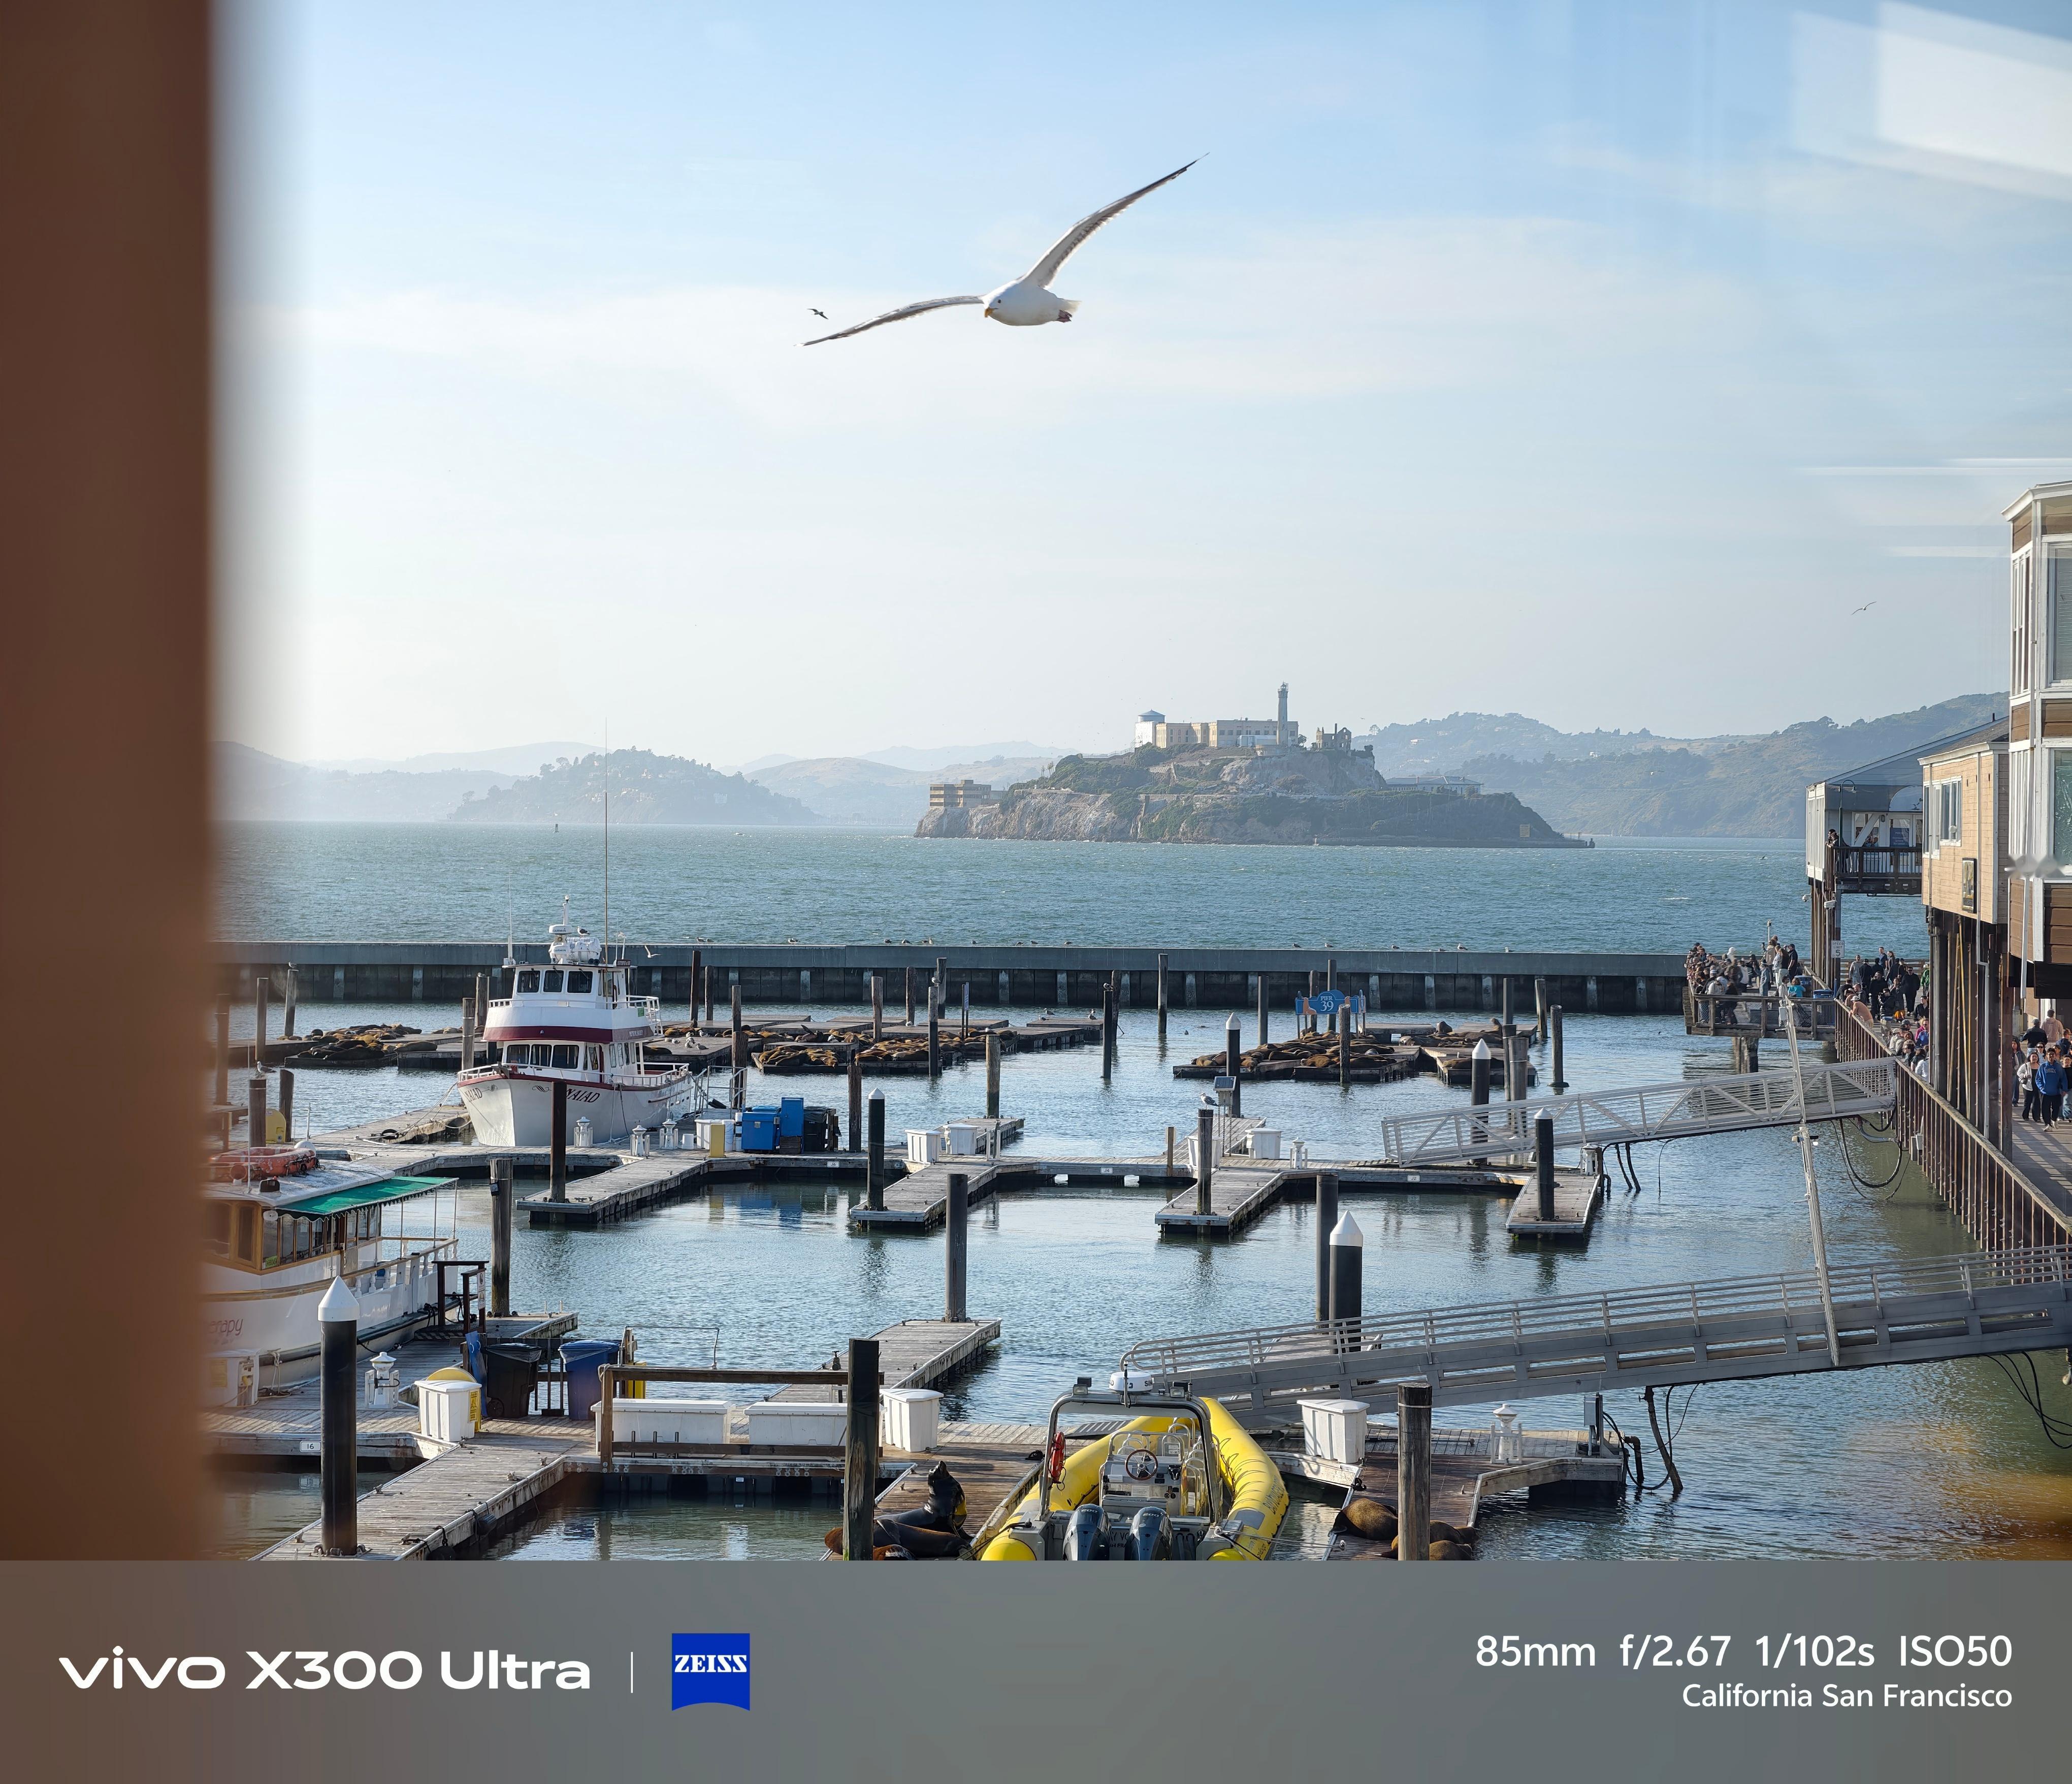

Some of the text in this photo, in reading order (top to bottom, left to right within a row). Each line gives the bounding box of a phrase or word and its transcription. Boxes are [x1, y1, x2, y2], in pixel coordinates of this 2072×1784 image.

[1320, 1001, 1334, 1011] 39
[464, 1088, 482, 1102] NAIAD
[566, 1088, 600, 1103] NAIAD
[208, 1319, 243, 1336] erapy
